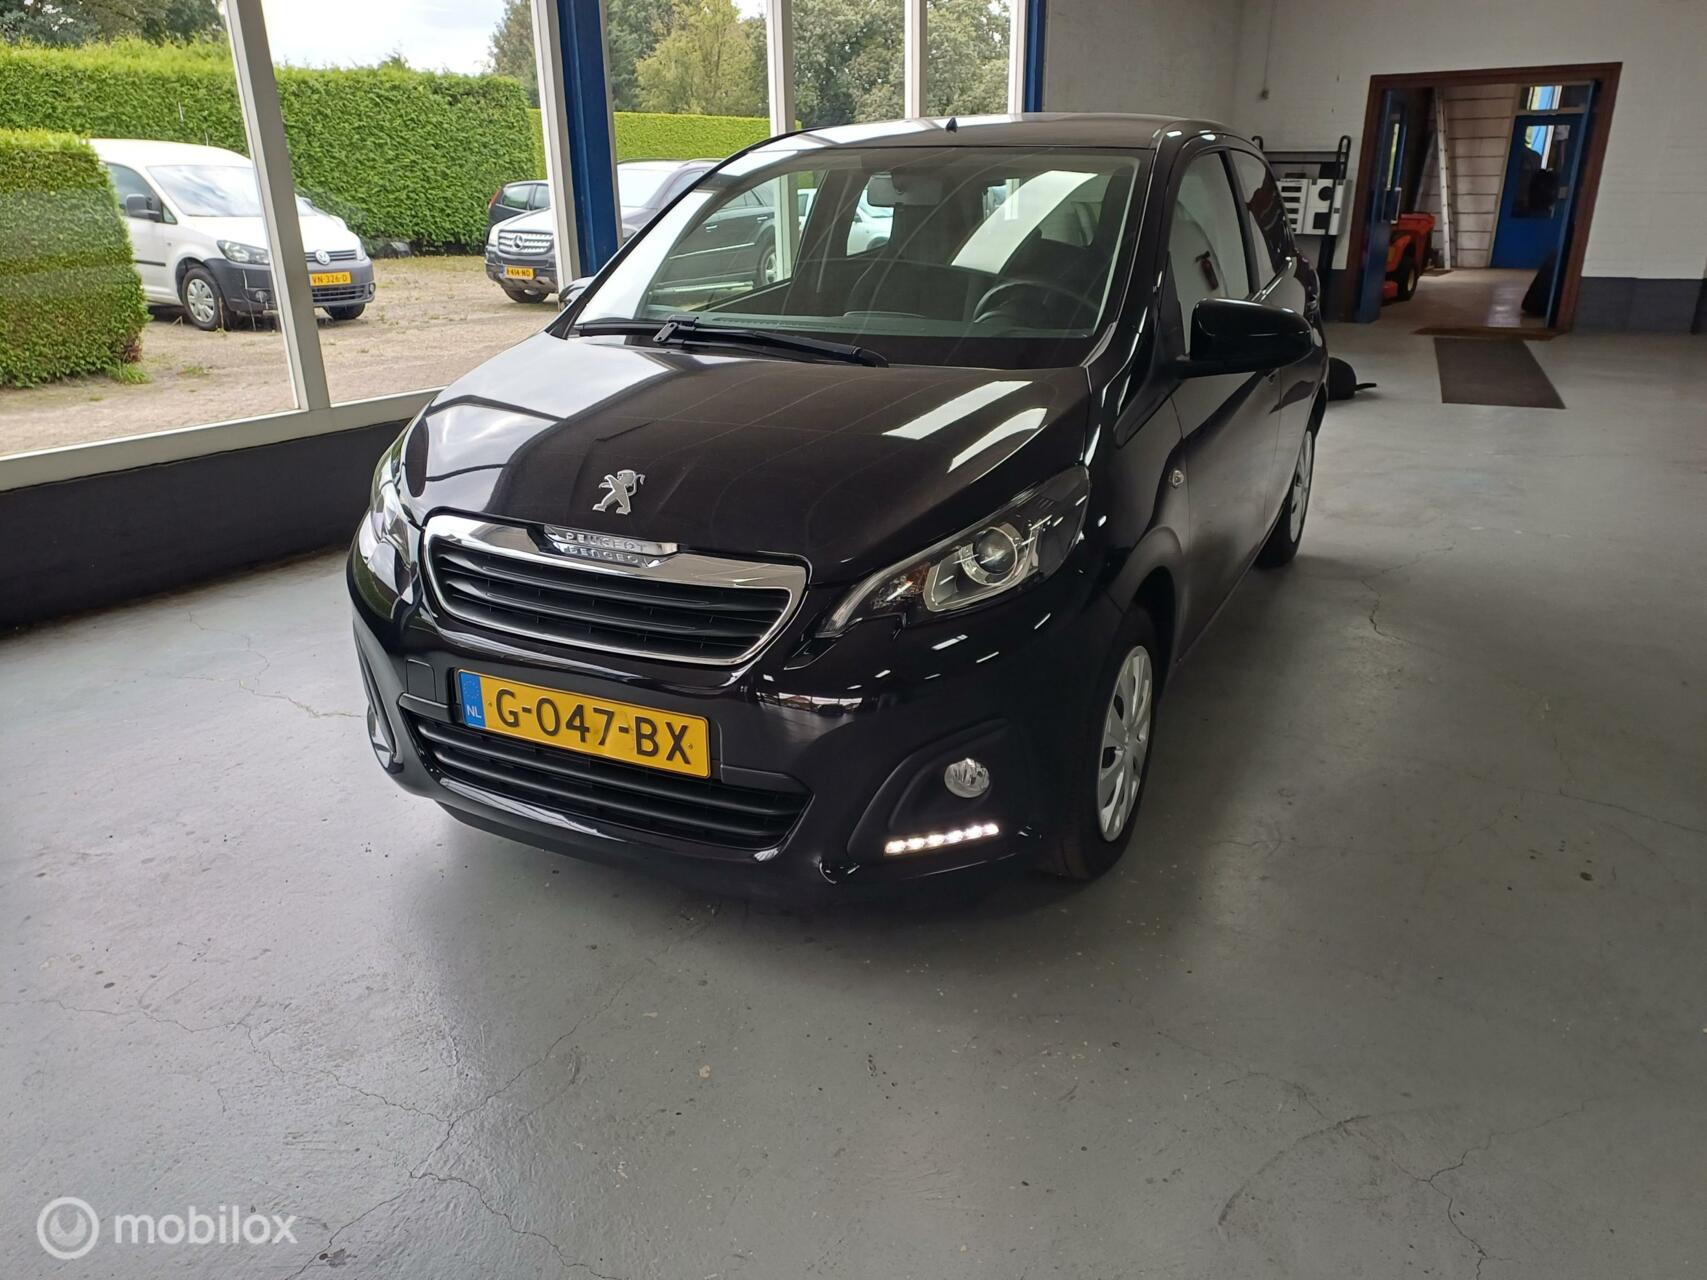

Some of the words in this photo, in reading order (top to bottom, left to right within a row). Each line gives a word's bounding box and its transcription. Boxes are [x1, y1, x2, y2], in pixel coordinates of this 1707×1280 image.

[564, 532, 647, 553] PEUGEOT
[466, 704, 483, 719] NL
[495, 688, 692, 765] G-047-BX
